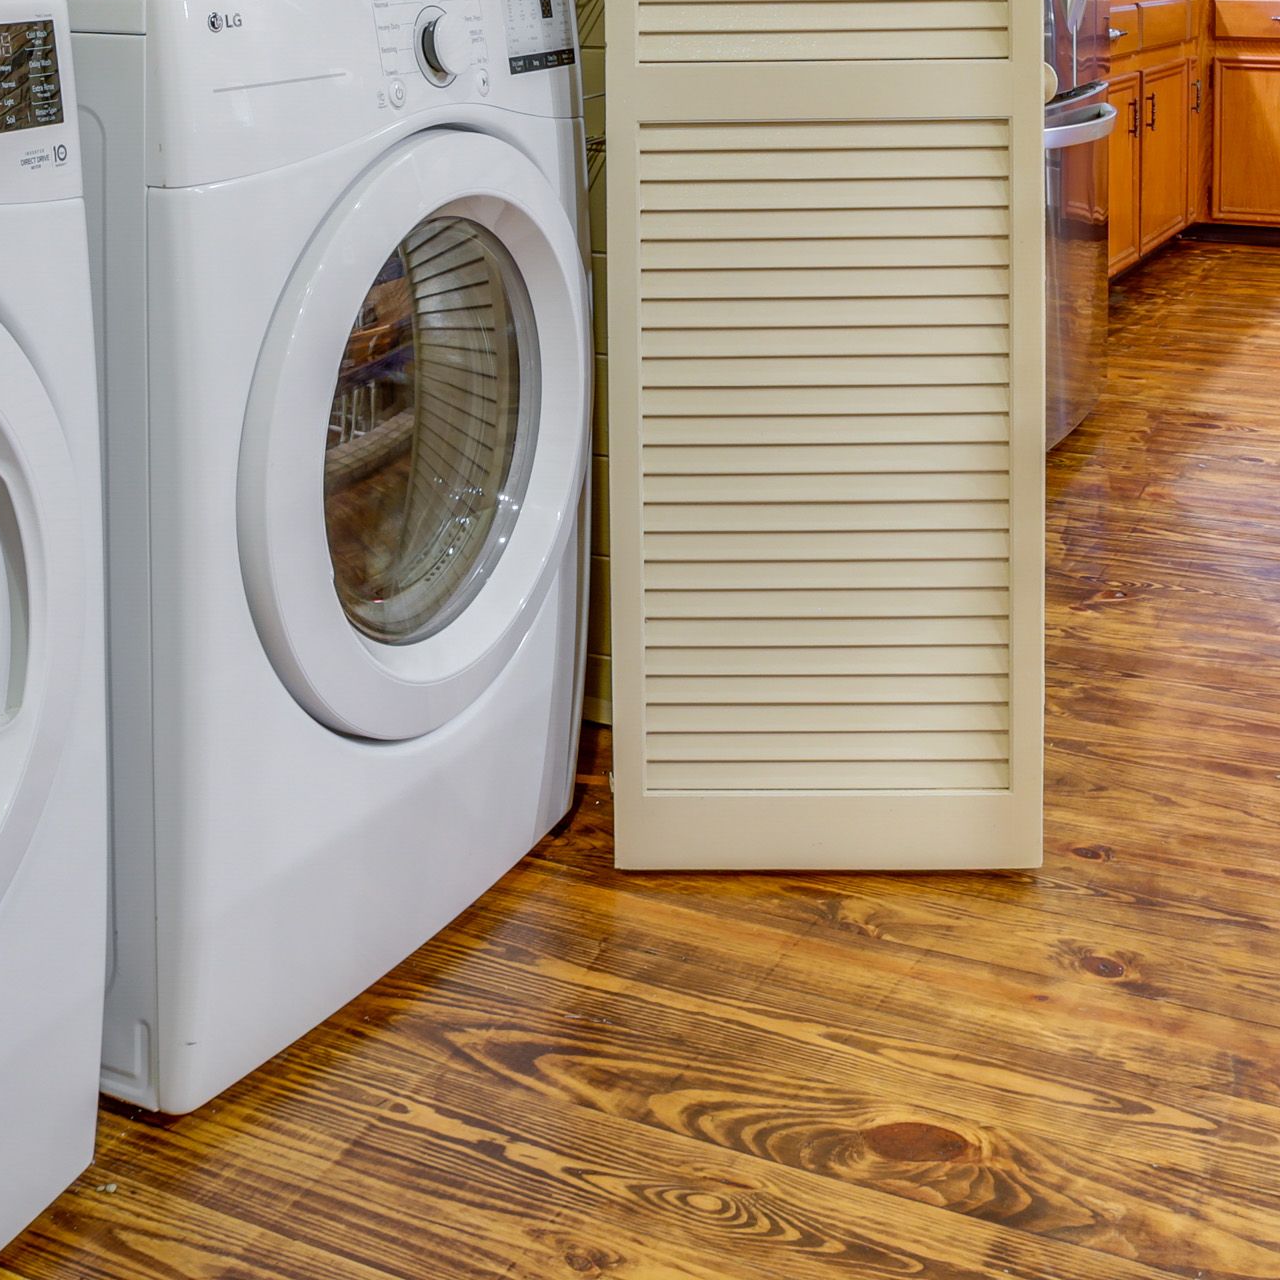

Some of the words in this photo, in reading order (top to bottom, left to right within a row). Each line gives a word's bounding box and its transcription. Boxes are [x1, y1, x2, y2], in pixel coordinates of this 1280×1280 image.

[225, 13, 242, 28] LG
[20, 156, 36, 167] DIRECT
[36, 153, 50, 162] DRIVE
